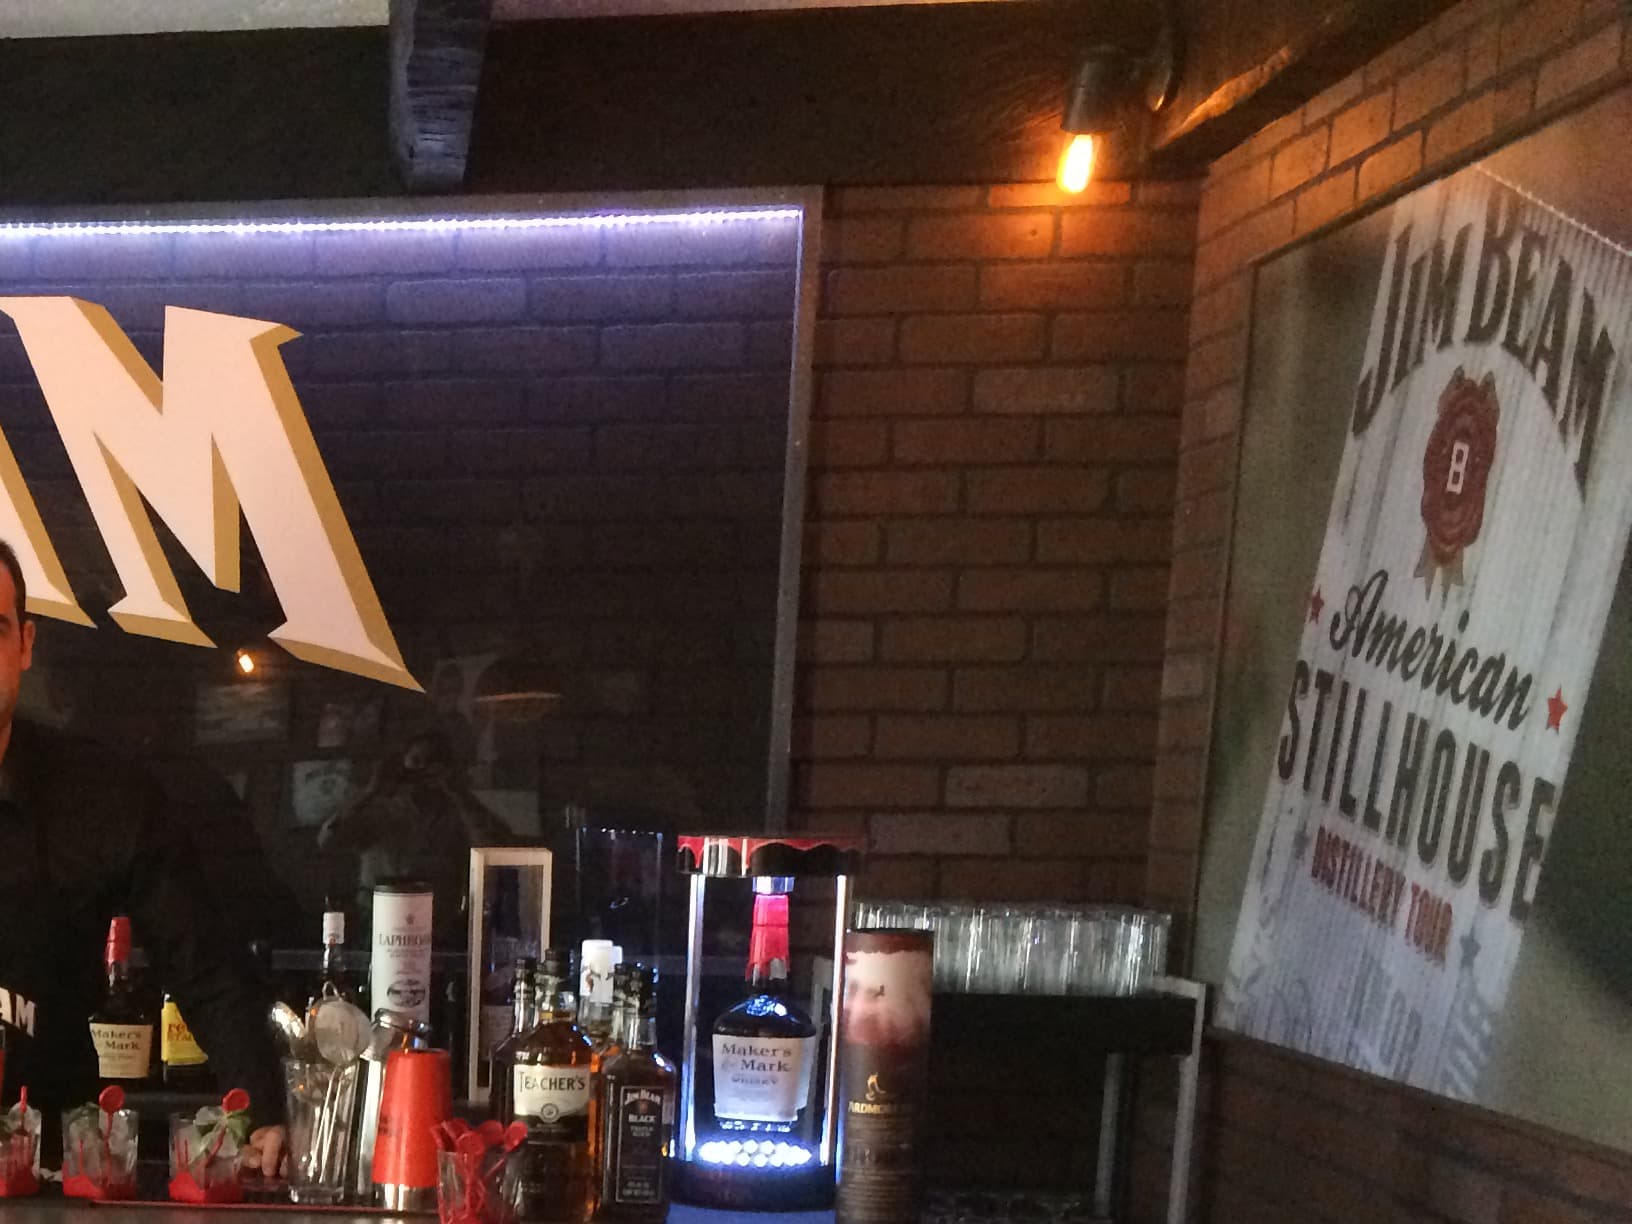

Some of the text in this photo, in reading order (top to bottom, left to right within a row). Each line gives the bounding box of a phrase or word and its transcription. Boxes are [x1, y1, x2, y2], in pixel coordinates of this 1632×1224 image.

[1352, 180, 1618, 506] JIM BEAM
[1446, 441, 1469, 495] B
[1329, 569, 1533, 731] American
[1277, 659, 1556, 922] STILLHOUSE
[721, 1043, 793, 1058] Maker's
[740, 1059, 792, 1073] Mark
[519, 1071, 586, 1093] TEACHER'S
